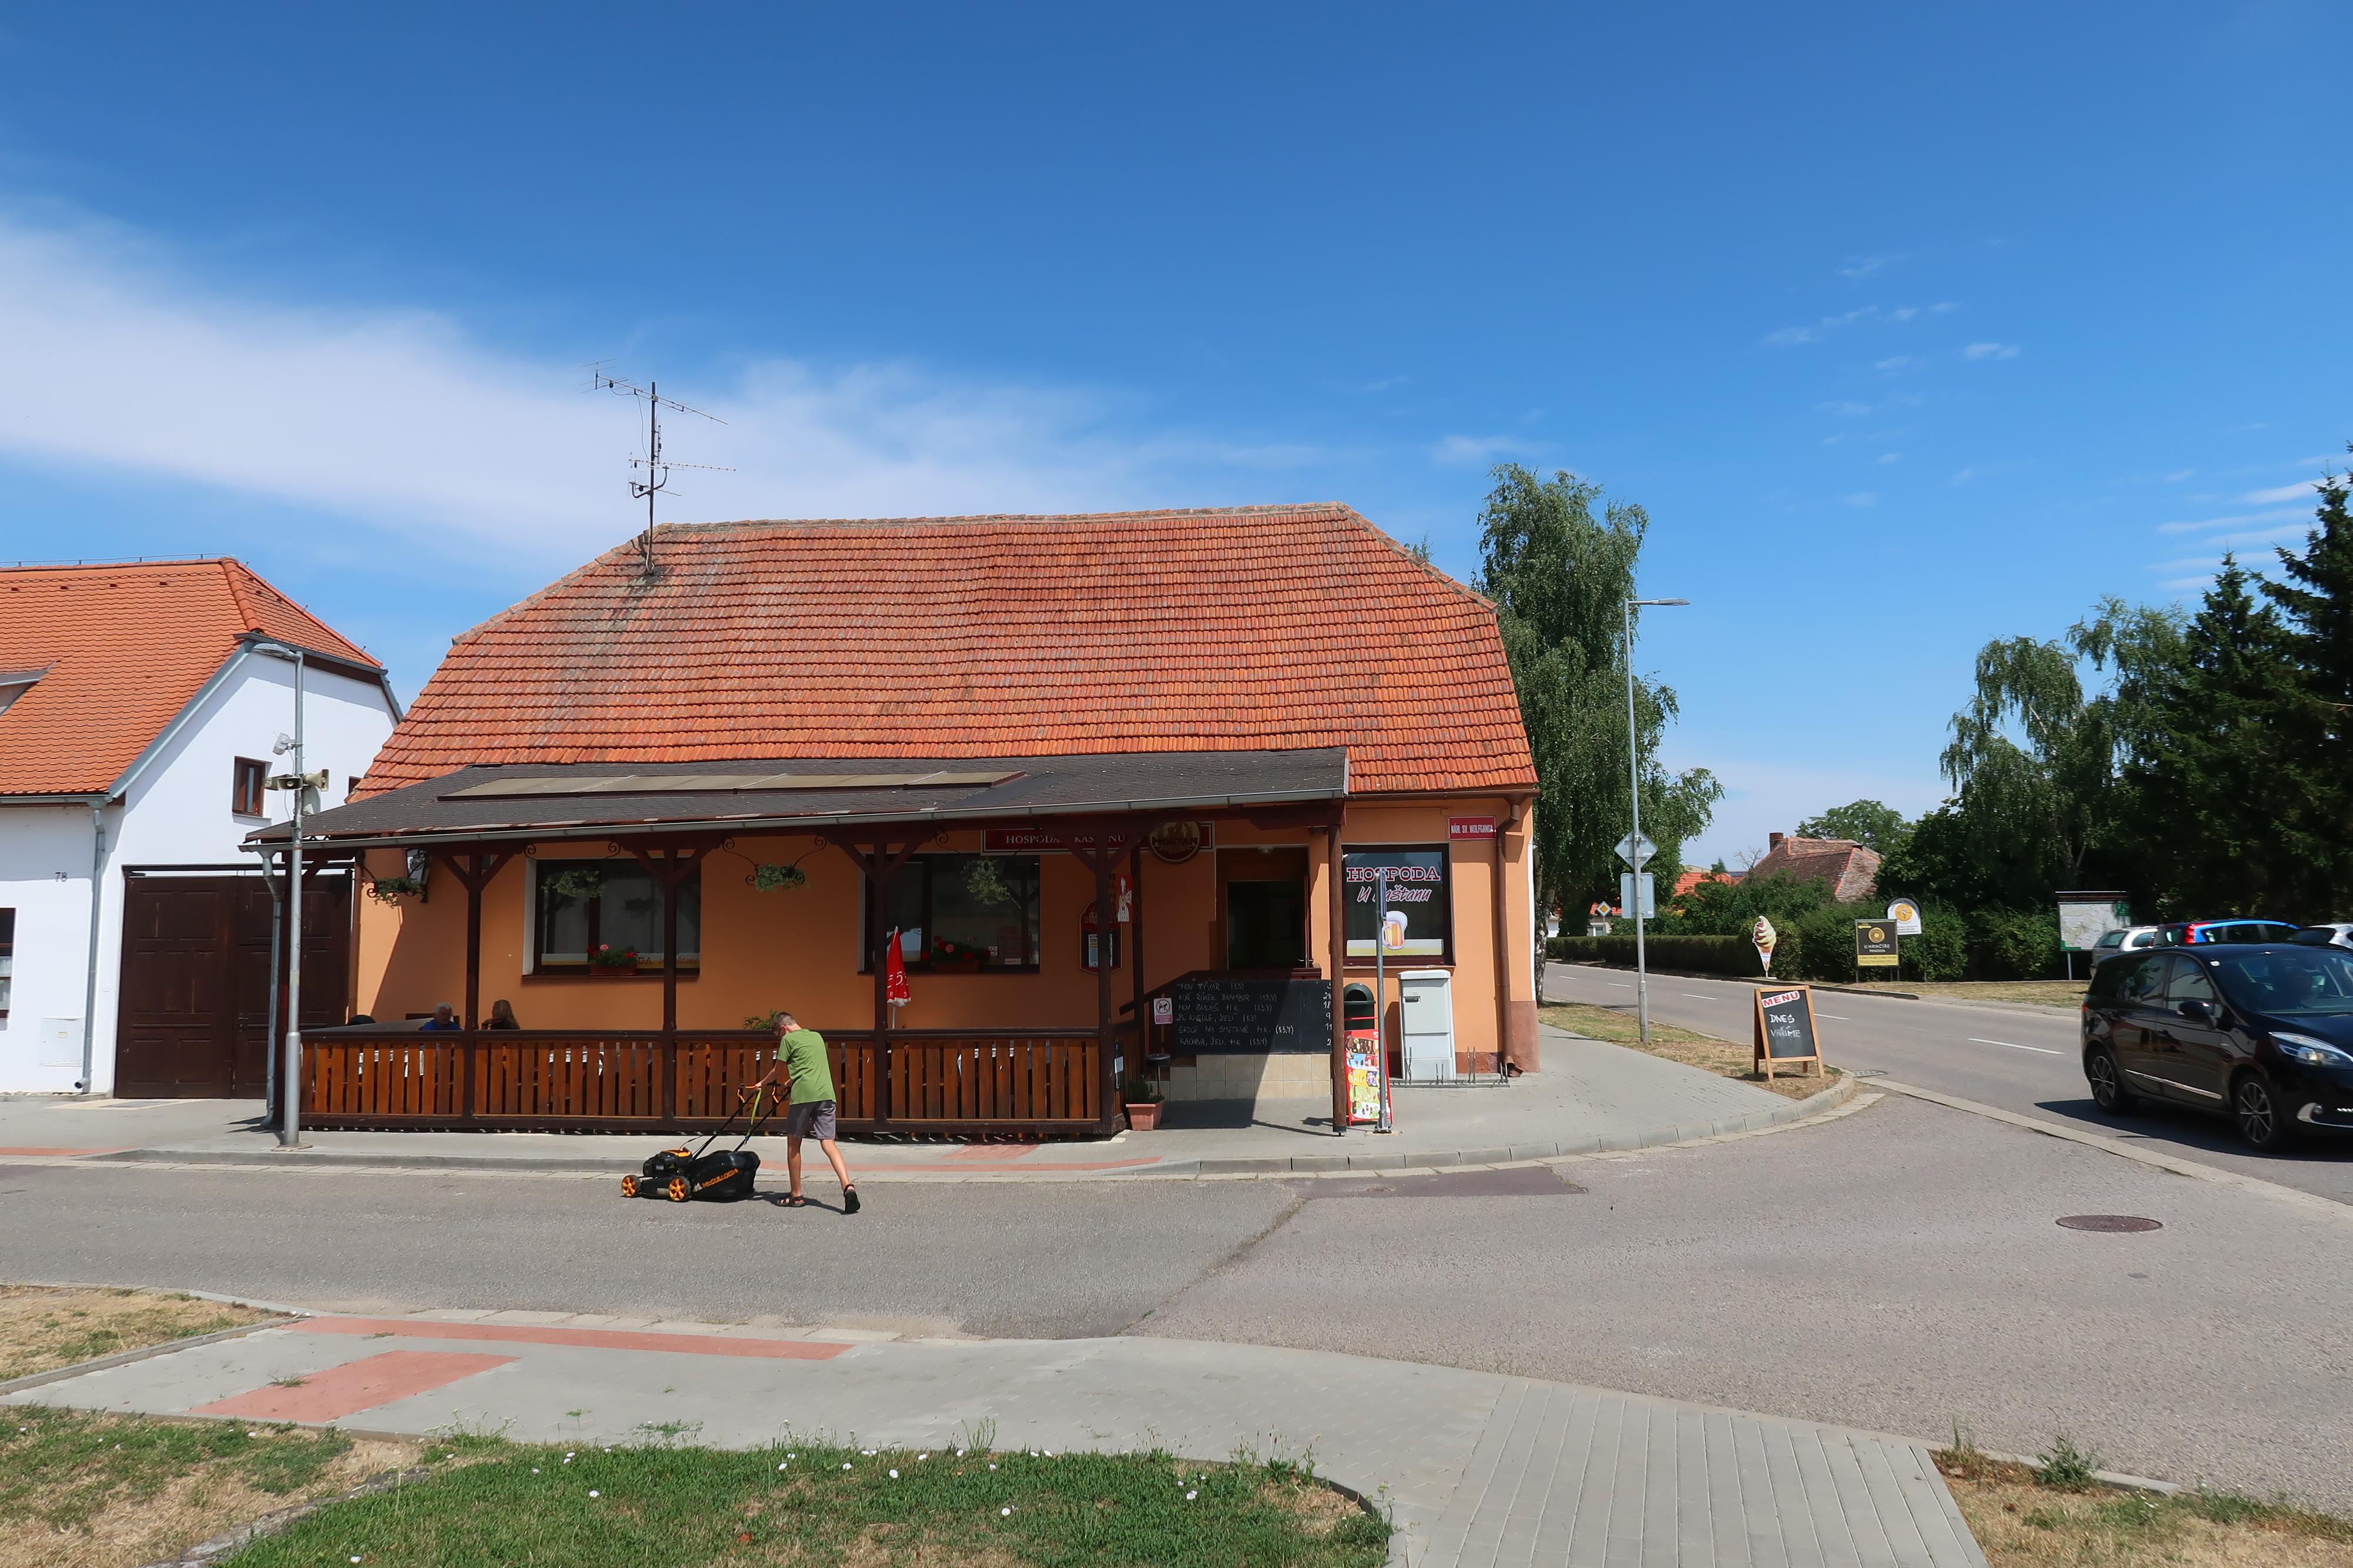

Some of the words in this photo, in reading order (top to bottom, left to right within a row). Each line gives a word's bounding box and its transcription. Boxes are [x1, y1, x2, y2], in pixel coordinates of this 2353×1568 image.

[1451, 823, 1461, 833] NÁM.
[1469, 825, 1494, 833] WOLFGANGA
[1152, 835, 1198, 846] HOSTAN
[55, 872, 67, 882] 78
[1357, 886, 1372, 903] U
[1372, 884, 1433, 903] aštanu
[1762, 991, 1799, 1007] MENU
[1769, 1014, 1795, 1023] DNES
